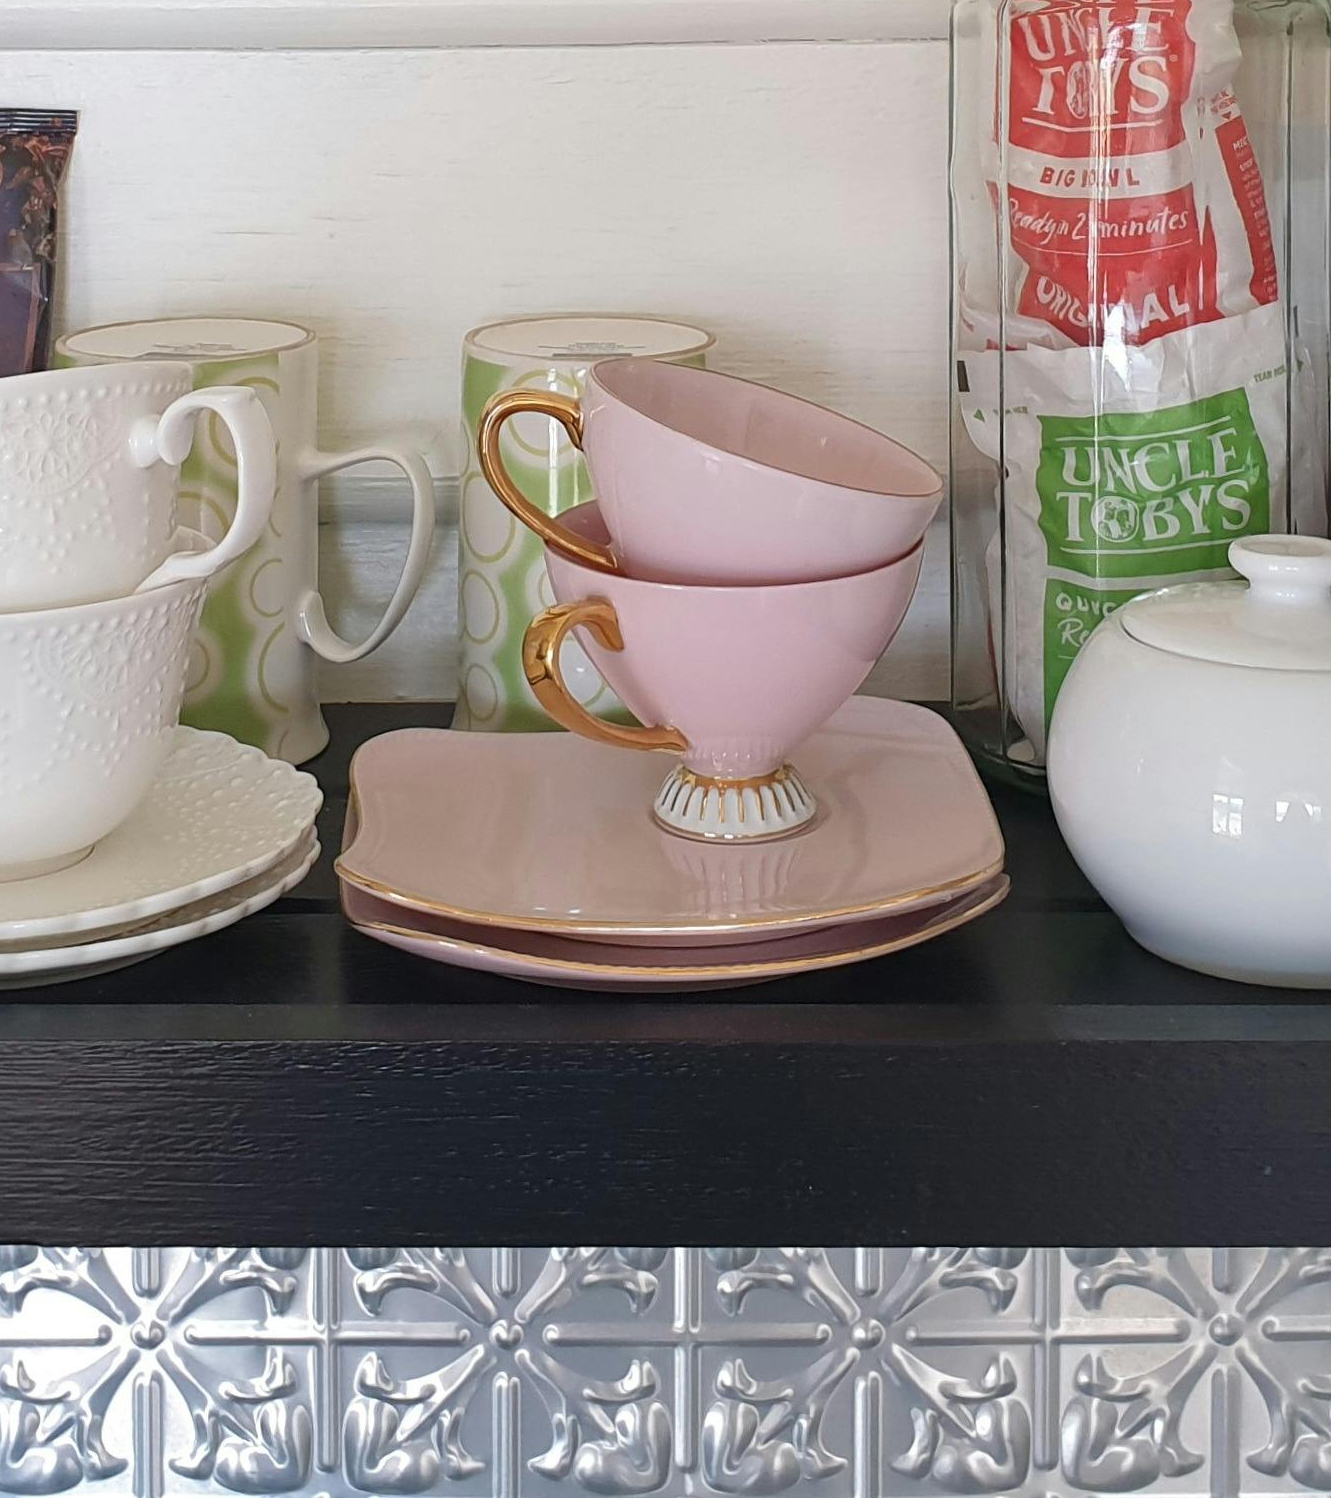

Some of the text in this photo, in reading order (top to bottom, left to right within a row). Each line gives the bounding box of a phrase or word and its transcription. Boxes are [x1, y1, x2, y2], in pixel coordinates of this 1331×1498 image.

[1040, 166, 1076, 187] BIG
[1071, 212, 1087, 240] 2
[1098, 206, 1189, 239] minutes
[1036, 275, 1191, 330] ORIGNAL
[1061, 427, 1245, 494] UNCLE
[1055, 479, 1251, 542] TOBYS
